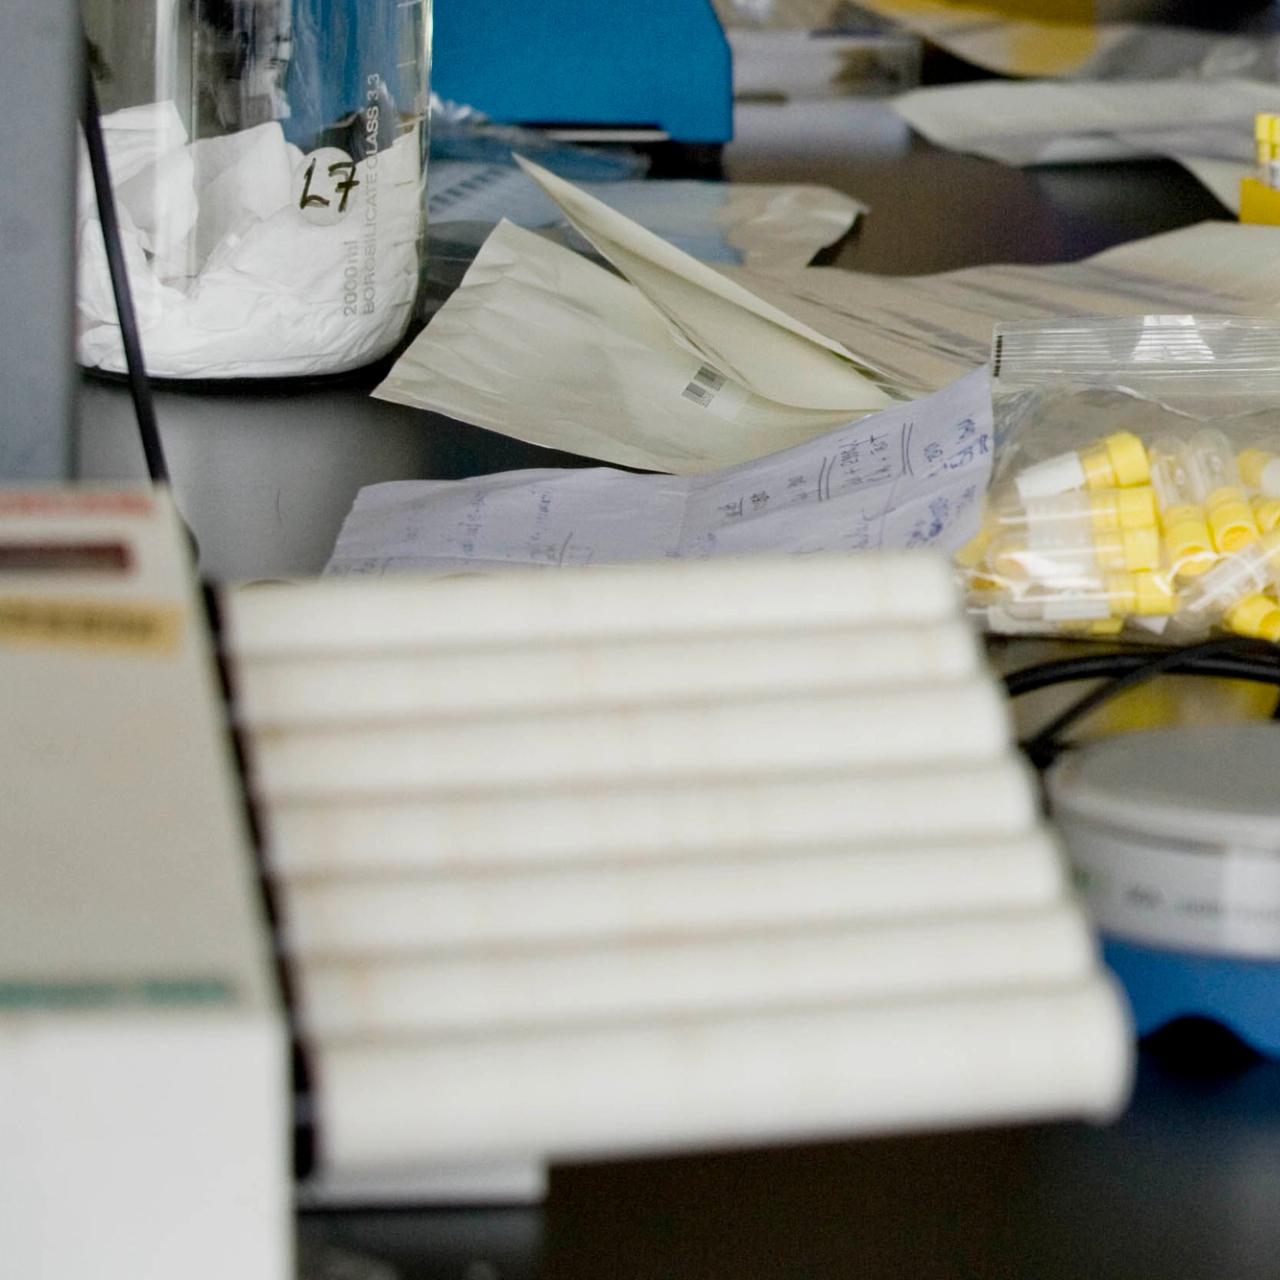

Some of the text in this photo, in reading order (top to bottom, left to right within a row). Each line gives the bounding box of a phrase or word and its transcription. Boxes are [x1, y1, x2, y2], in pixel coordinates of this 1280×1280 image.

[300, 158, 360, 212] L7
[362, 172, 378, 315] BOROSILICATE
[343, 266, 358, 317] 2000
